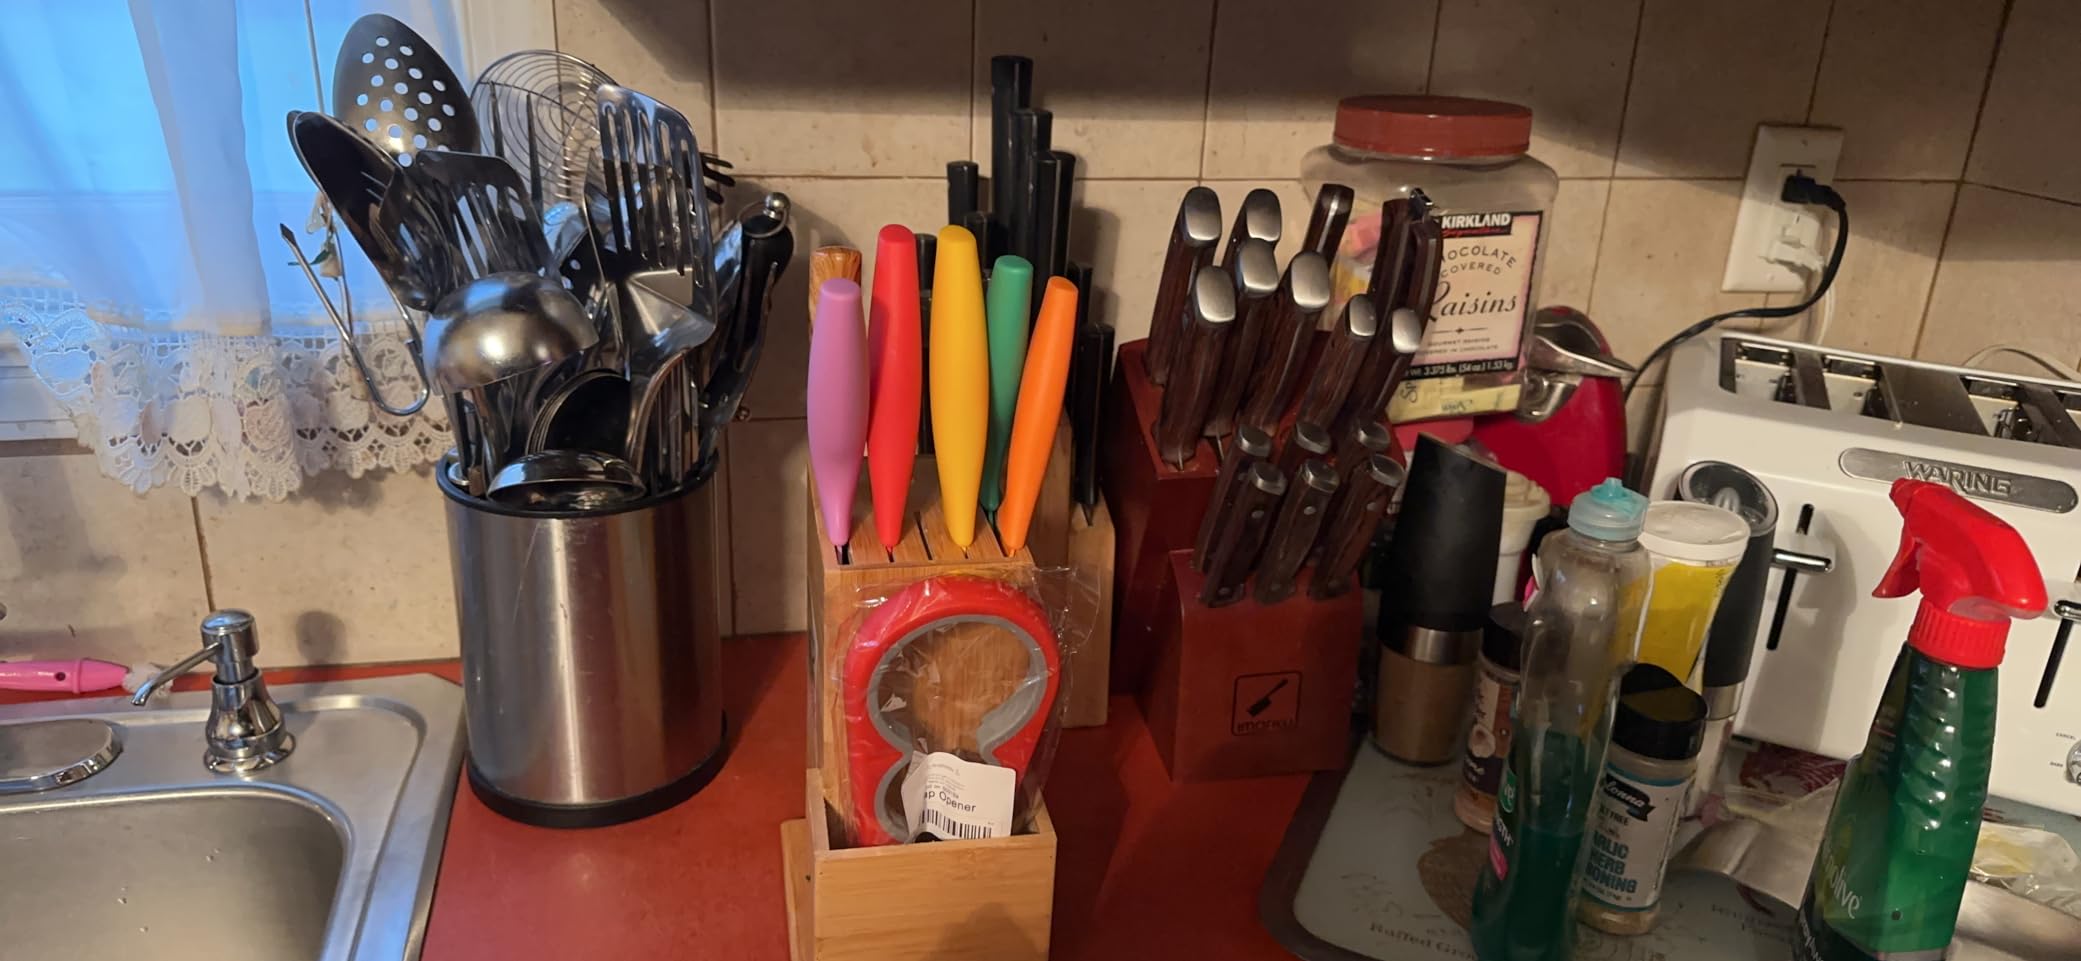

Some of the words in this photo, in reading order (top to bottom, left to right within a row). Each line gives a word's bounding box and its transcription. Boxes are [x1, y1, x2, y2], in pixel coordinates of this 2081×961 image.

[1441, 213, 1512, 229] KIRKLAND
[1442, 245, 1517, 269] OCOLATE
[1440, 261, 1501, 279] COVERED
[1903, 460, 2012, 496] WARING
[939, 790, 976, 813] Opener
[1593, 830, 1629, 860] ARLIC
